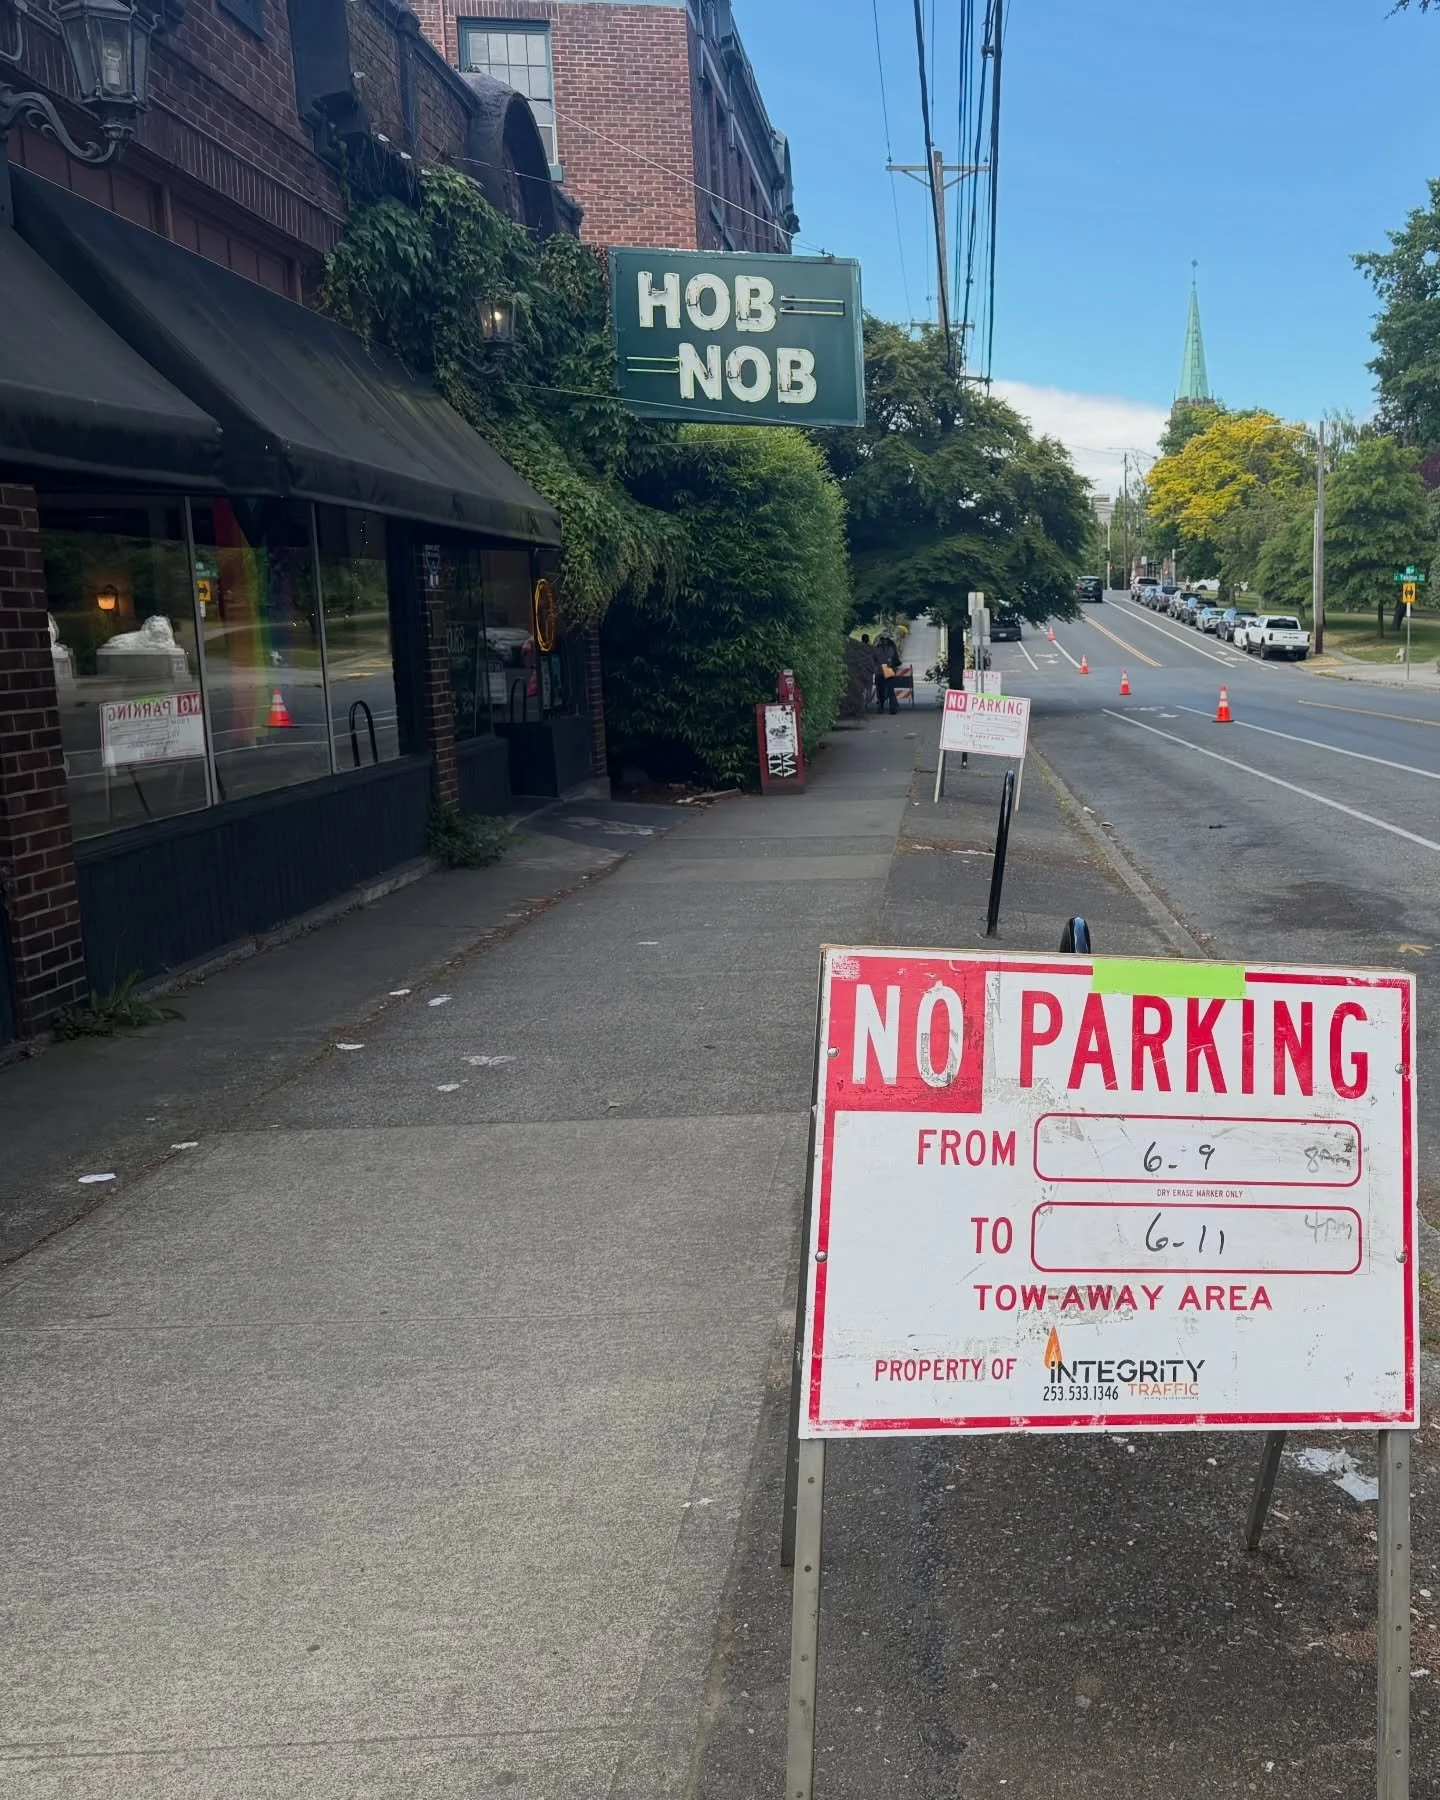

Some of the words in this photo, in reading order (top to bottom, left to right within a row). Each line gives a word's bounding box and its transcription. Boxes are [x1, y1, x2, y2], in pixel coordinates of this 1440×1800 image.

[638, 271, 777, 332] HOB
[678, 343, 817, 404] NOB
[948, 693, 966, 711] NO
[972, 697, 1023, 716] PARKING
[852, 983, 964, 1088] NO
[1019, 990, 1369, 1100] PARKING
[918, 1129, 1016, 1167] FROM
[1157, 1188, 1171, 1197] DRY
[1172, 1189, 1194, 1197] ERASE
[1196, 1189, 1224, 1198] MARKER
[1225, 1190, 1244, 1198] ONLY
[971, 1216, 1013, 1254] TO
[974, 1284, 1164, 1311] TOW-AWAY
[1178, 1285, 1273, 1311] AREA
[875, 1358, 982, 1381] PROPERTY
[991, 1358, 1017, 1380] OF
[1043, 1385, 1119, 1401] 253.533.1346
[1127, 1383, 1199, 1397] TRAFFIC
